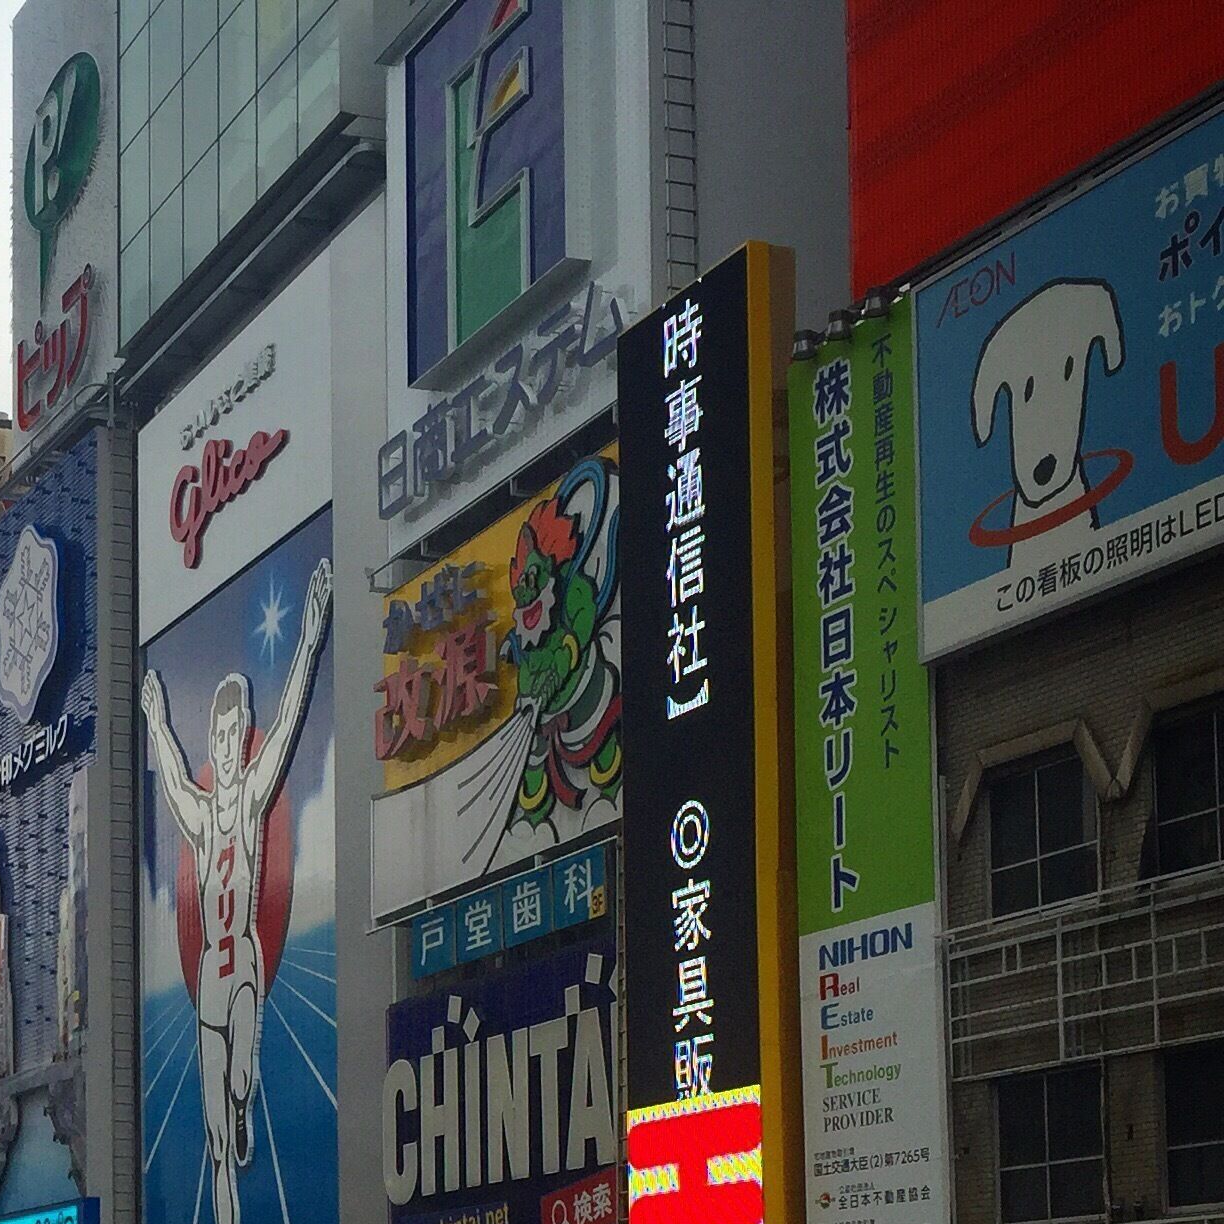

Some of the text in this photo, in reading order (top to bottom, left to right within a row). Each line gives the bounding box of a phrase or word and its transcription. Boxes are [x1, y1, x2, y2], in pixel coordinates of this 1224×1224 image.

[15, 261, 95, 434] ピップ
[169, 429, 292, 570] Glico
[871, 334, 901, 770] 不動産再生のスペシャリスト
[811, 352, 860, 915] 株式会社日本リート
[373, 618, 499, 760] 改源
[216, 844, 235, 979] グリコ
[819, 922, 913, 970] NIHON
[819, 972, 860, 1000] Real
[821, 1003, 874, 1030] Estate
[821, 1031, 898, 1060] Investment
[820, 1061, 902, 1089] Technology
[822, 1087, 881, 1113] SERVICE
[823, 1106, 895, 1133] PROVIDER
[838, 1184, 932, 1211] 全日本不動産協会
